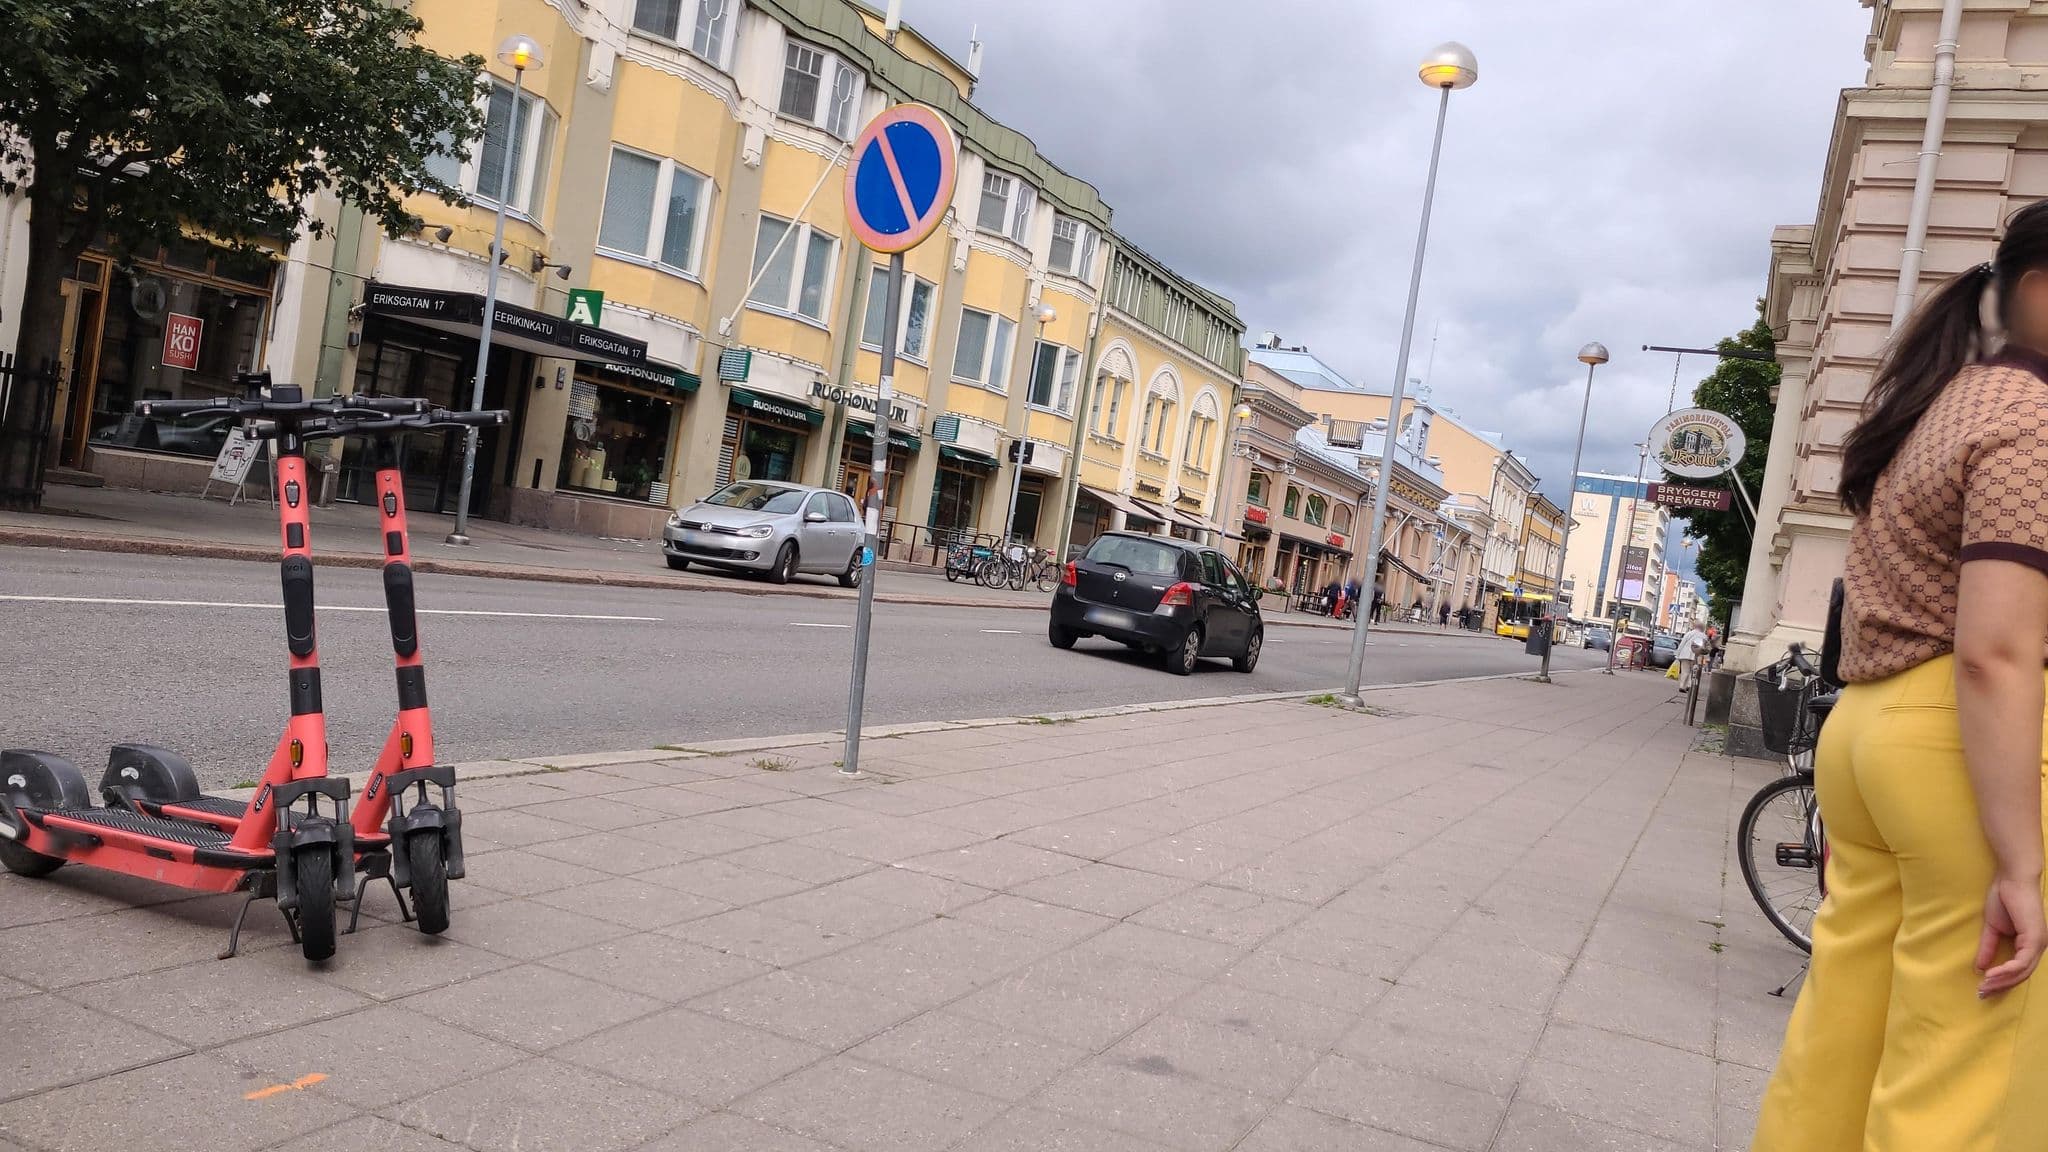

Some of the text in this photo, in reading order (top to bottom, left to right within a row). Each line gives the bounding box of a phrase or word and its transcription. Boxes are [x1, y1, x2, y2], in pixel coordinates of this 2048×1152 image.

[373, 293, 445, 311] ERIKSGATAN 17
[172, 323, 196, 337] HAN
[494, 310, 553, 335] EERIKINKATU
[170, 334, 195, 352] KO
[579, 334, 641, 358] ERIKSGATAN 17
[169, 349, 193, 361] SUSHI
[605, 363, 676, 387] RUOHONJUURI
[752, 399, 807, 421] RUOHONJUURI
[1657, 485, 1722, 500] BRYGGERI
[1657, 494, 1720, 508] BREWERY
